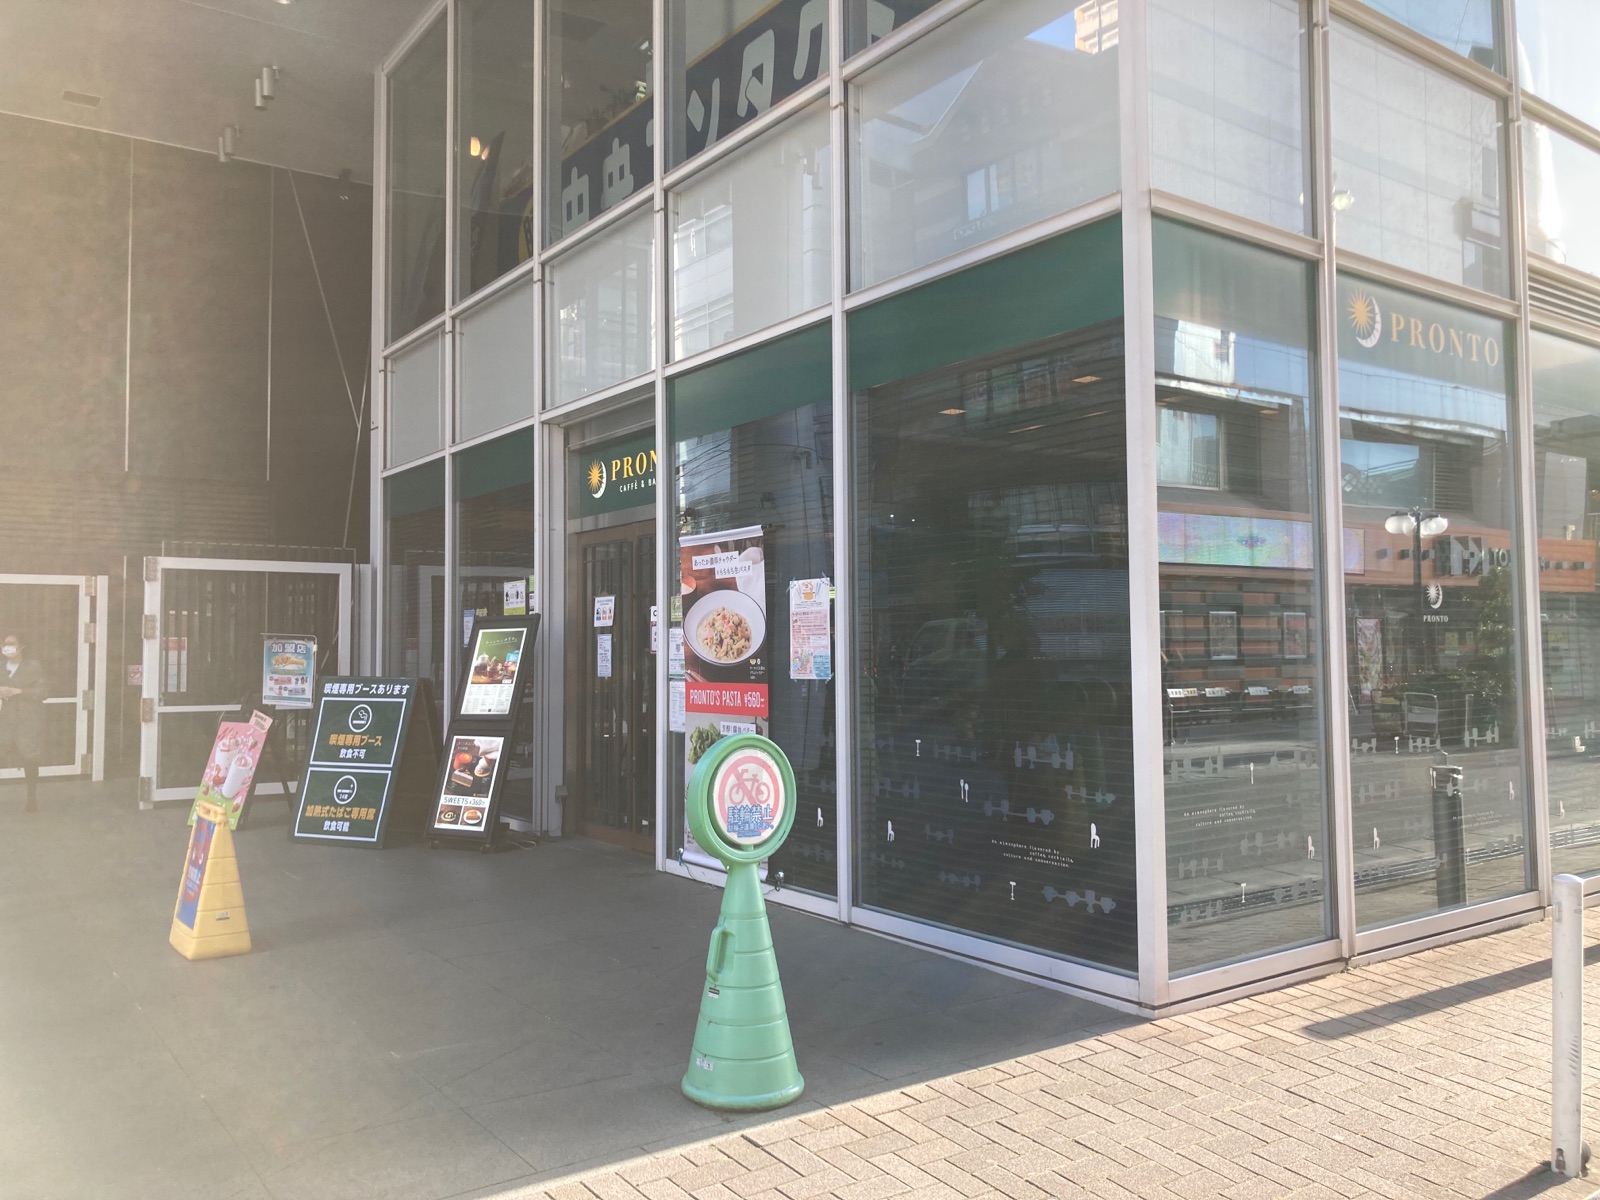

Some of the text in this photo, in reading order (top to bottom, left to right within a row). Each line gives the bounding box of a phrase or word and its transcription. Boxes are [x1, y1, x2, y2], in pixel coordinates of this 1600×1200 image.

[1390, 312, 1500, 367] PRONTO
[640, 479, 645, 488] &
[1423, 614, 1449, 623] PRONTO
[271, 642, 307, 654] 加盟店
[323, 683, 410, 695] 喫煙専用ブースあります
[689, 689, 721, 706] PRONTO'S
[722, 691, 742, 707] PASTA
[328, 733, 383, 747] 喫煙専用ブース
[339, 748, 366, 759] 飲食不可
[443, 796, 469, 805] SWEETS
[305, 804, 377, 821] 加熱式たばこ専用席
[727, 804, 774, 824] 駐輪禁止
[323, 820, 350, 832] 飲食可能
